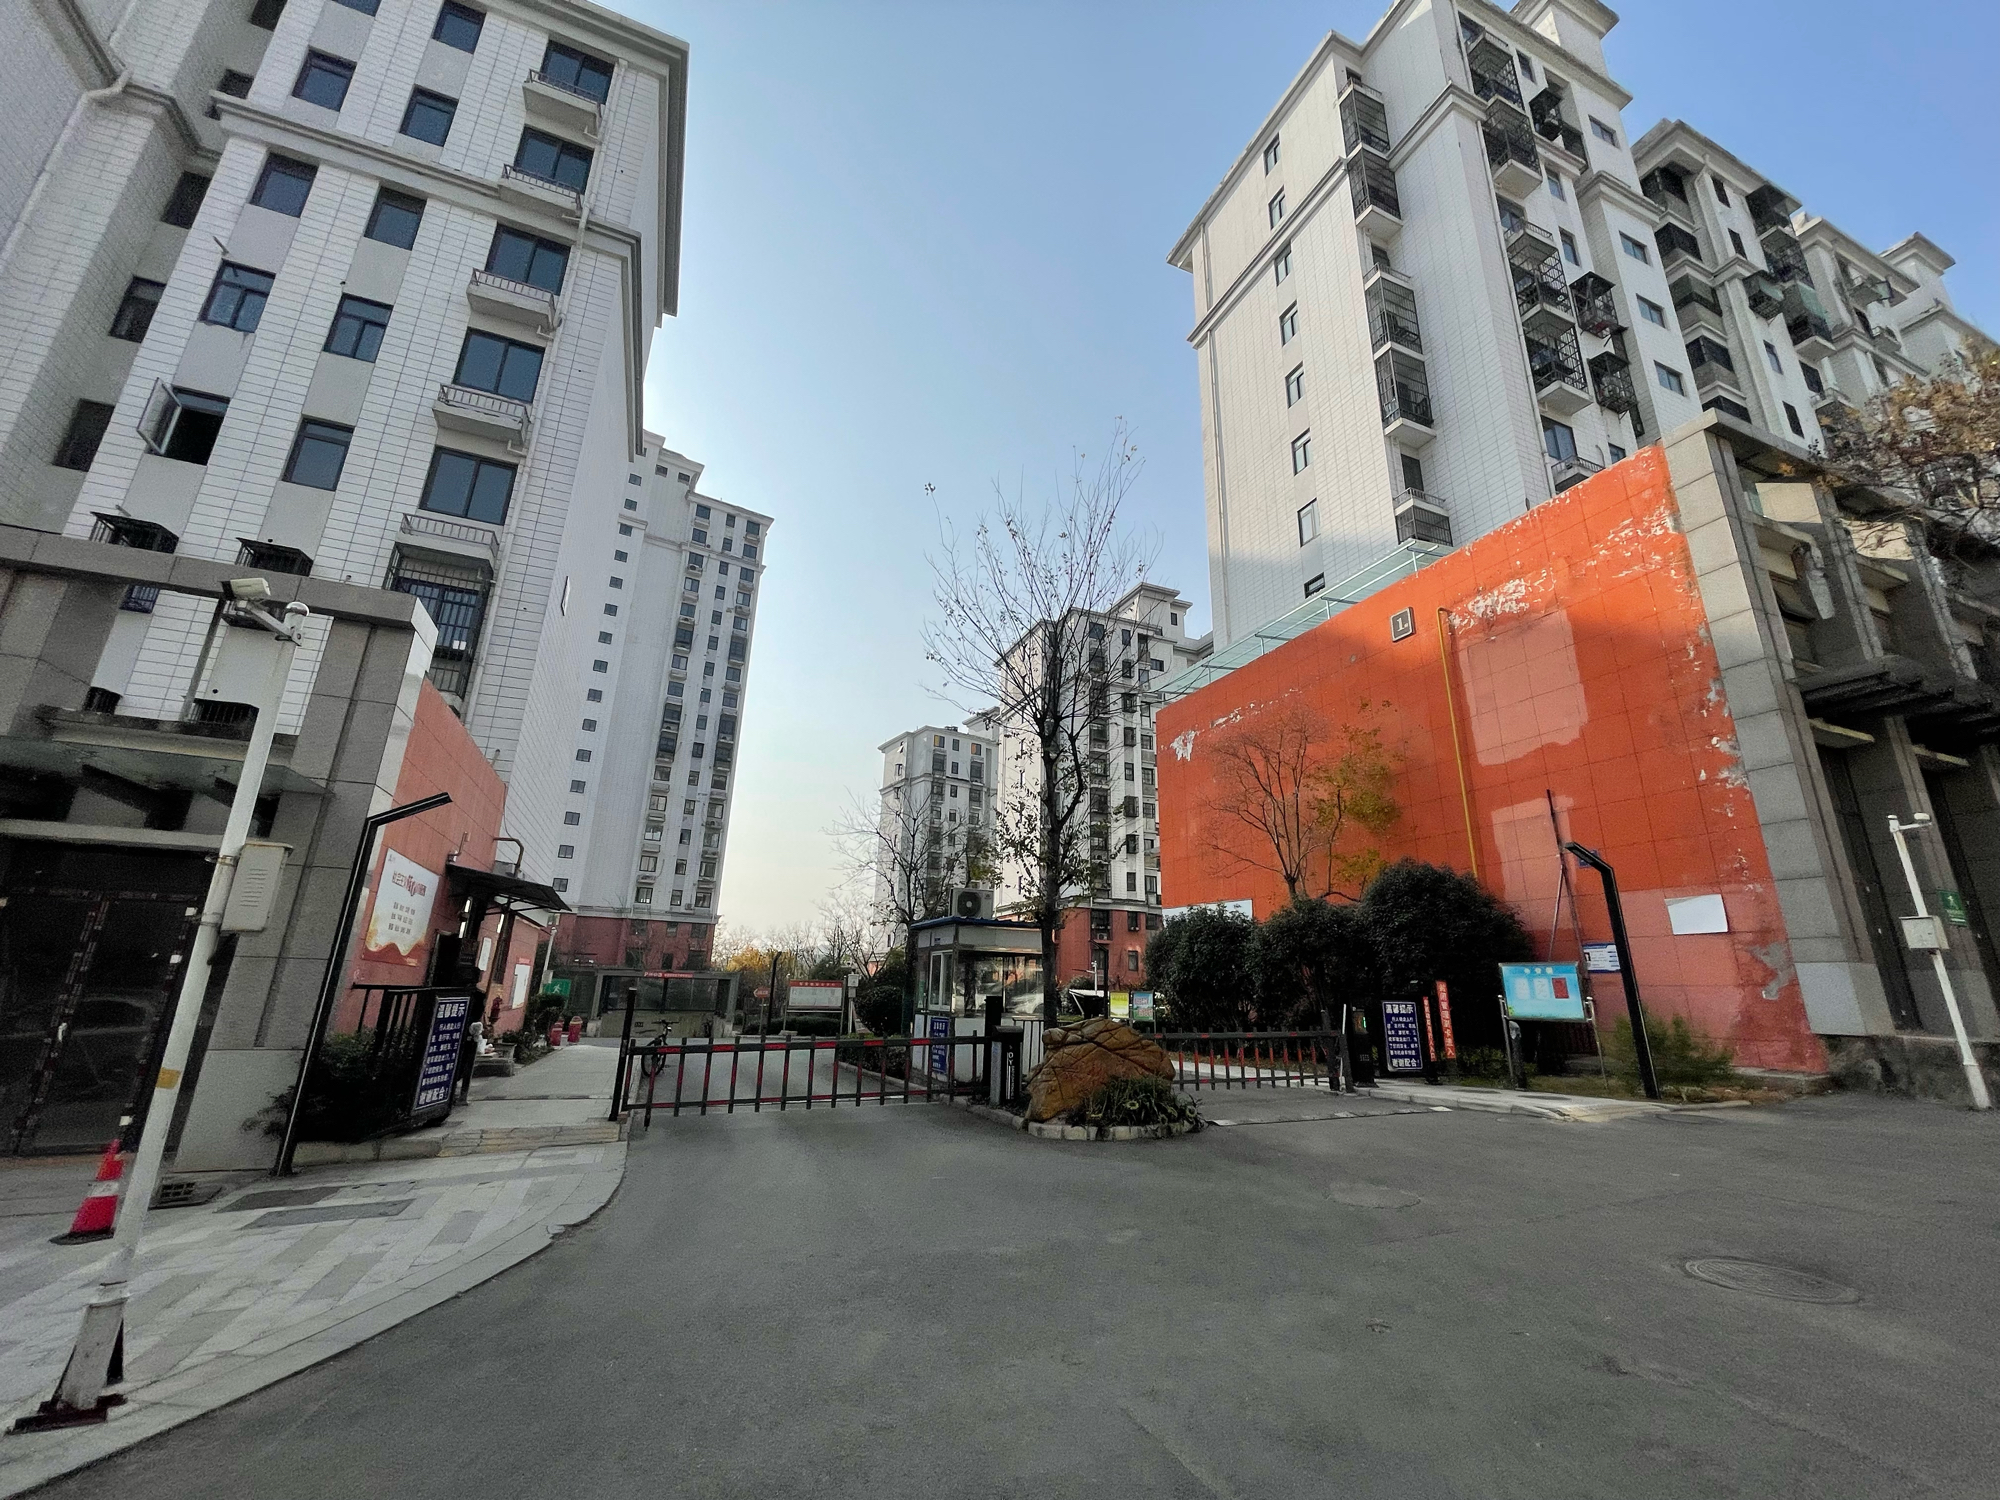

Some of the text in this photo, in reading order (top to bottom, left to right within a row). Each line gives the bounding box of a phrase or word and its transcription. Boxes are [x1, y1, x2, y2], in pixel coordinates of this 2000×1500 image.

[437, 1003, 465, 1019] 温馨提示
[1386, 1004, 1413, 1013] 温馨提示
